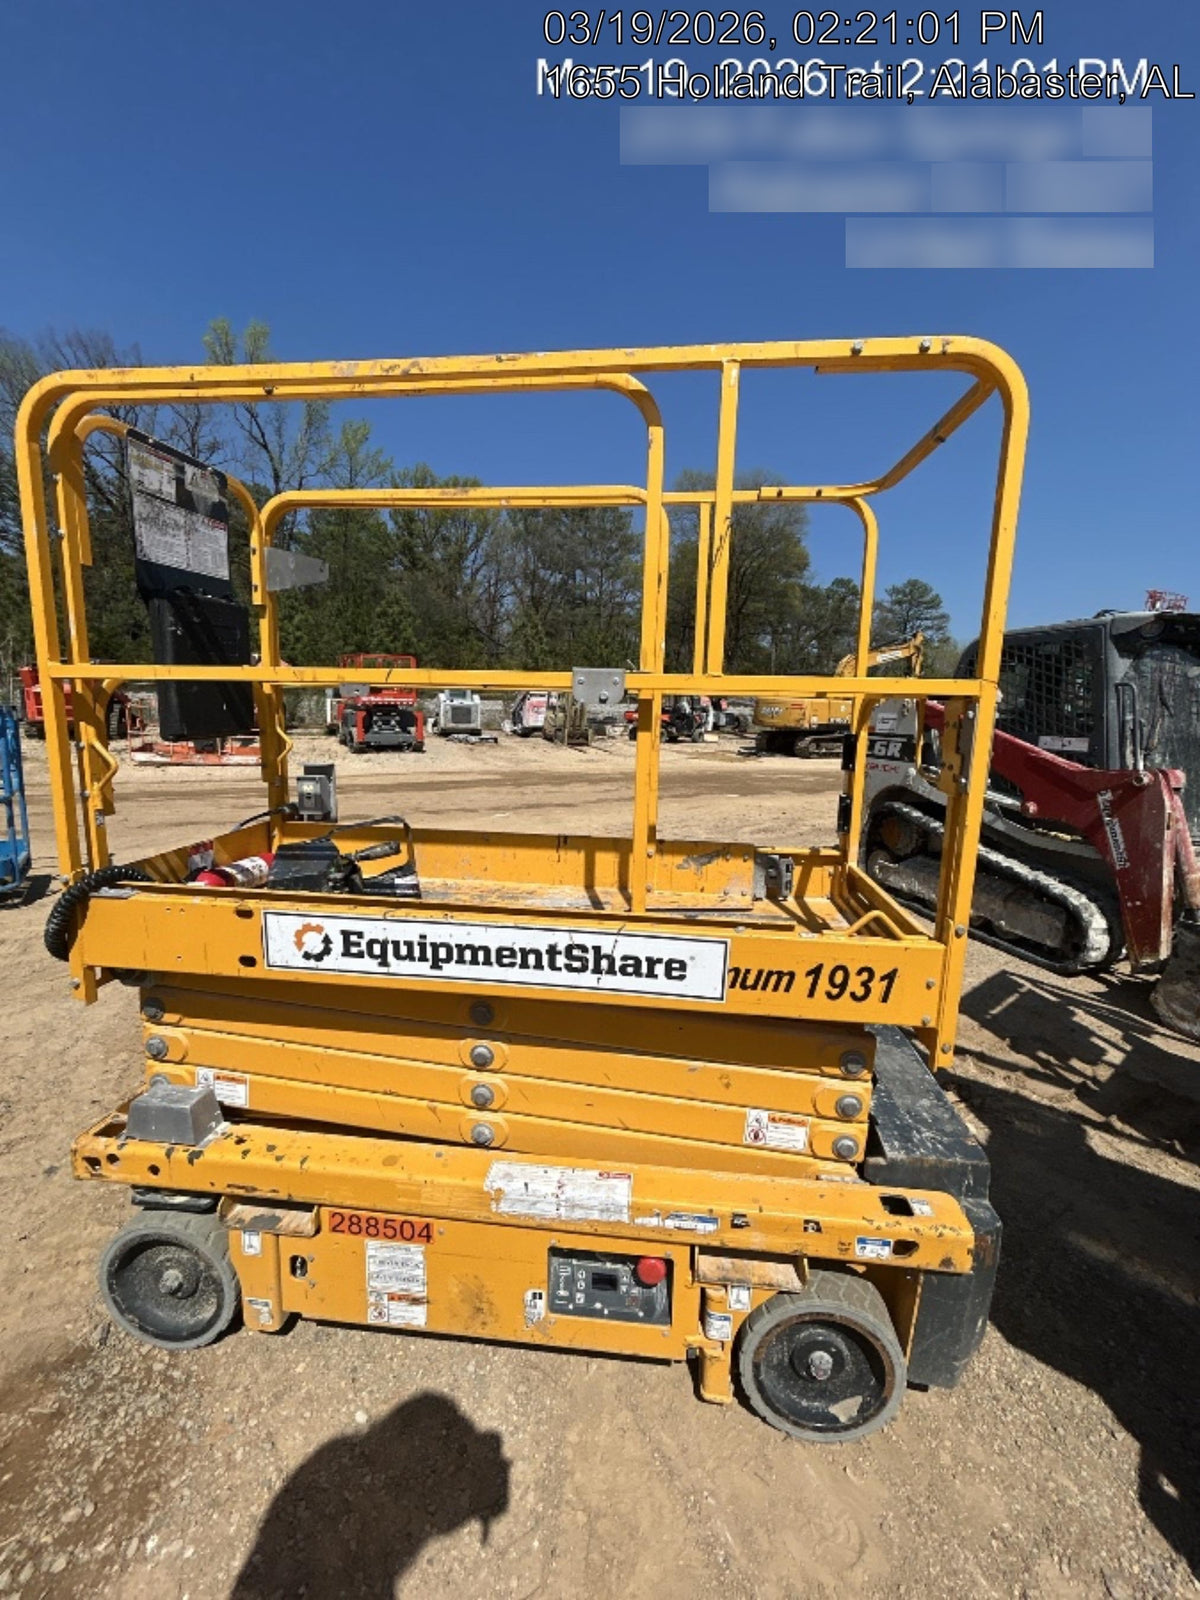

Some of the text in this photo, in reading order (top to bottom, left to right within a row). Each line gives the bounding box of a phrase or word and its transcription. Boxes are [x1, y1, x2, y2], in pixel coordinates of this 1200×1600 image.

[867, 740, 902, 758] 6R
[340, 929, 687, 982] EquipmentShare
[805, 963, 899, 1003] 1931
[331, 1212, 432, 1243] 288504
